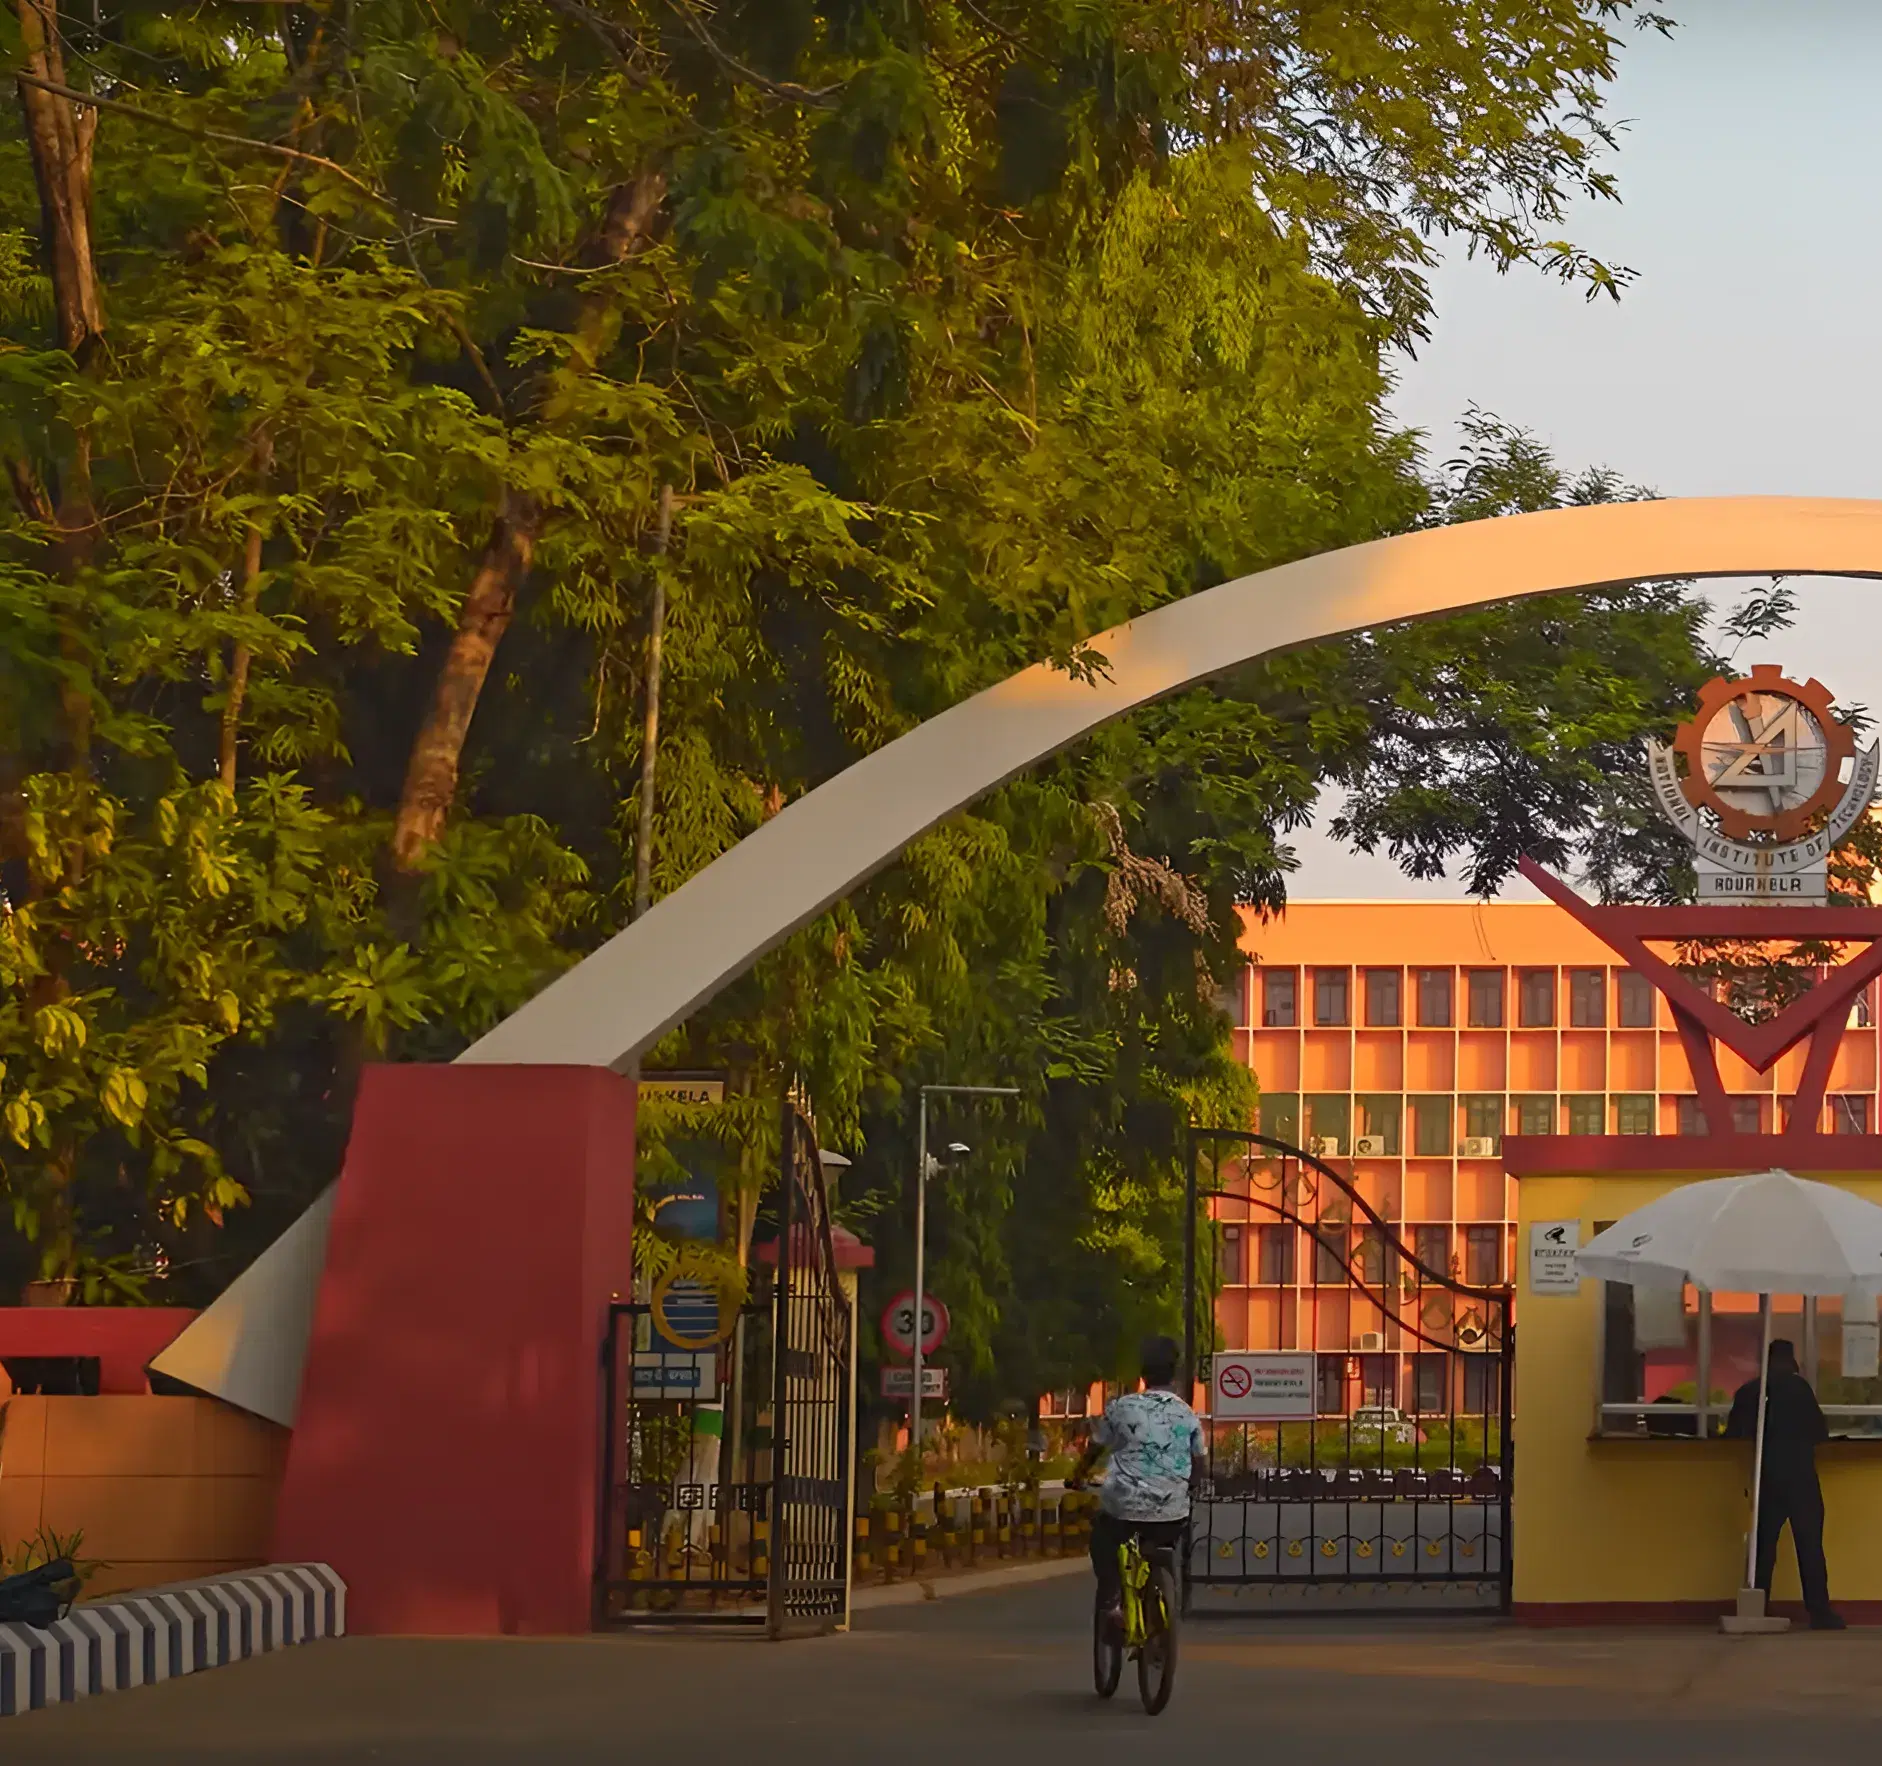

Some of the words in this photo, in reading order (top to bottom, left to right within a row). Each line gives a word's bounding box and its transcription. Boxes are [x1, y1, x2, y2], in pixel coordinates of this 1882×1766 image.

[1655, 756, 1691, 821] NATIONAL
[1703, 838, 1799, 867] INSTITUTE
[1805, 837, 1823, 857] OF
[1831, 757, 1874, 829] TECHNOLOGY
[1715, 877, 1802, 892] ROURKELA
[897, 1309, 936, 1335] 30
